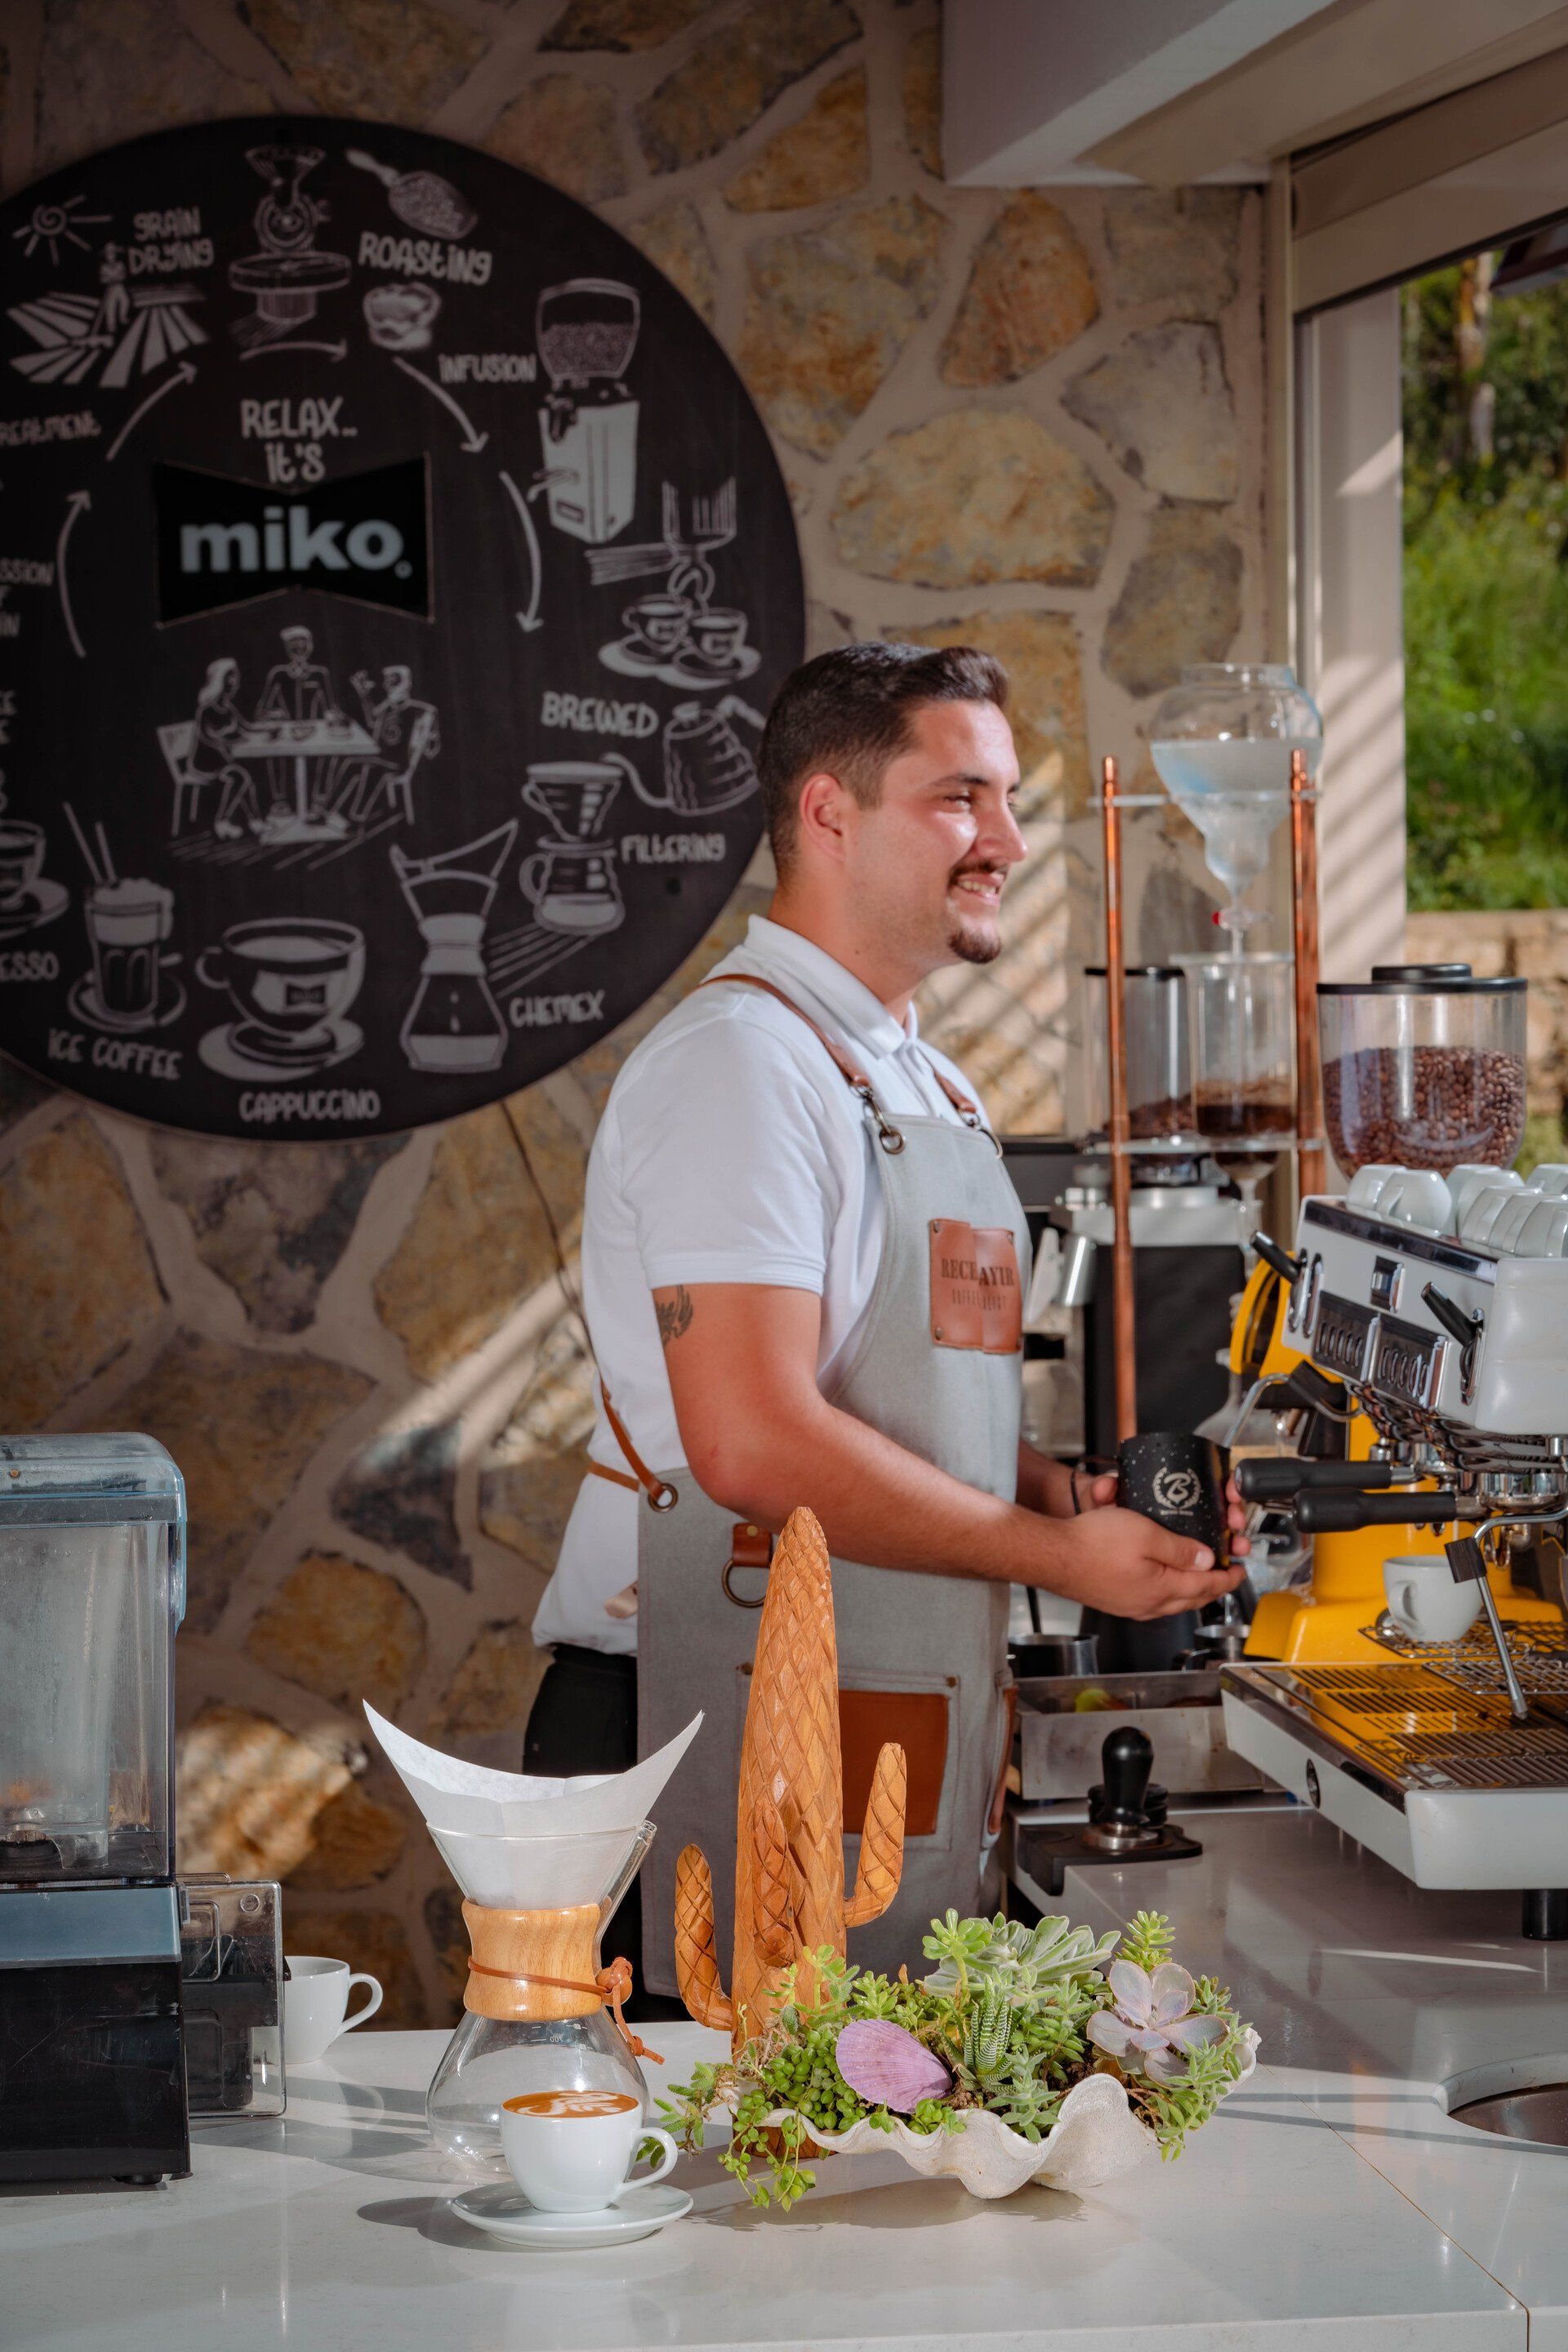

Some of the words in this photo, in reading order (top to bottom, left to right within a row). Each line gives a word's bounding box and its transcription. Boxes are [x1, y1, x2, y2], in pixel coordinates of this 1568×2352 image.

[541, 690, 660, 739] BREWED
[509, 988, 606, 1027] CHEMEX
[47, 1027, 86, 1063] ICE
[91, 1036, 184, 1080] COFFEE
[238, 1088, 381, 1125] CAPPUCCINO
